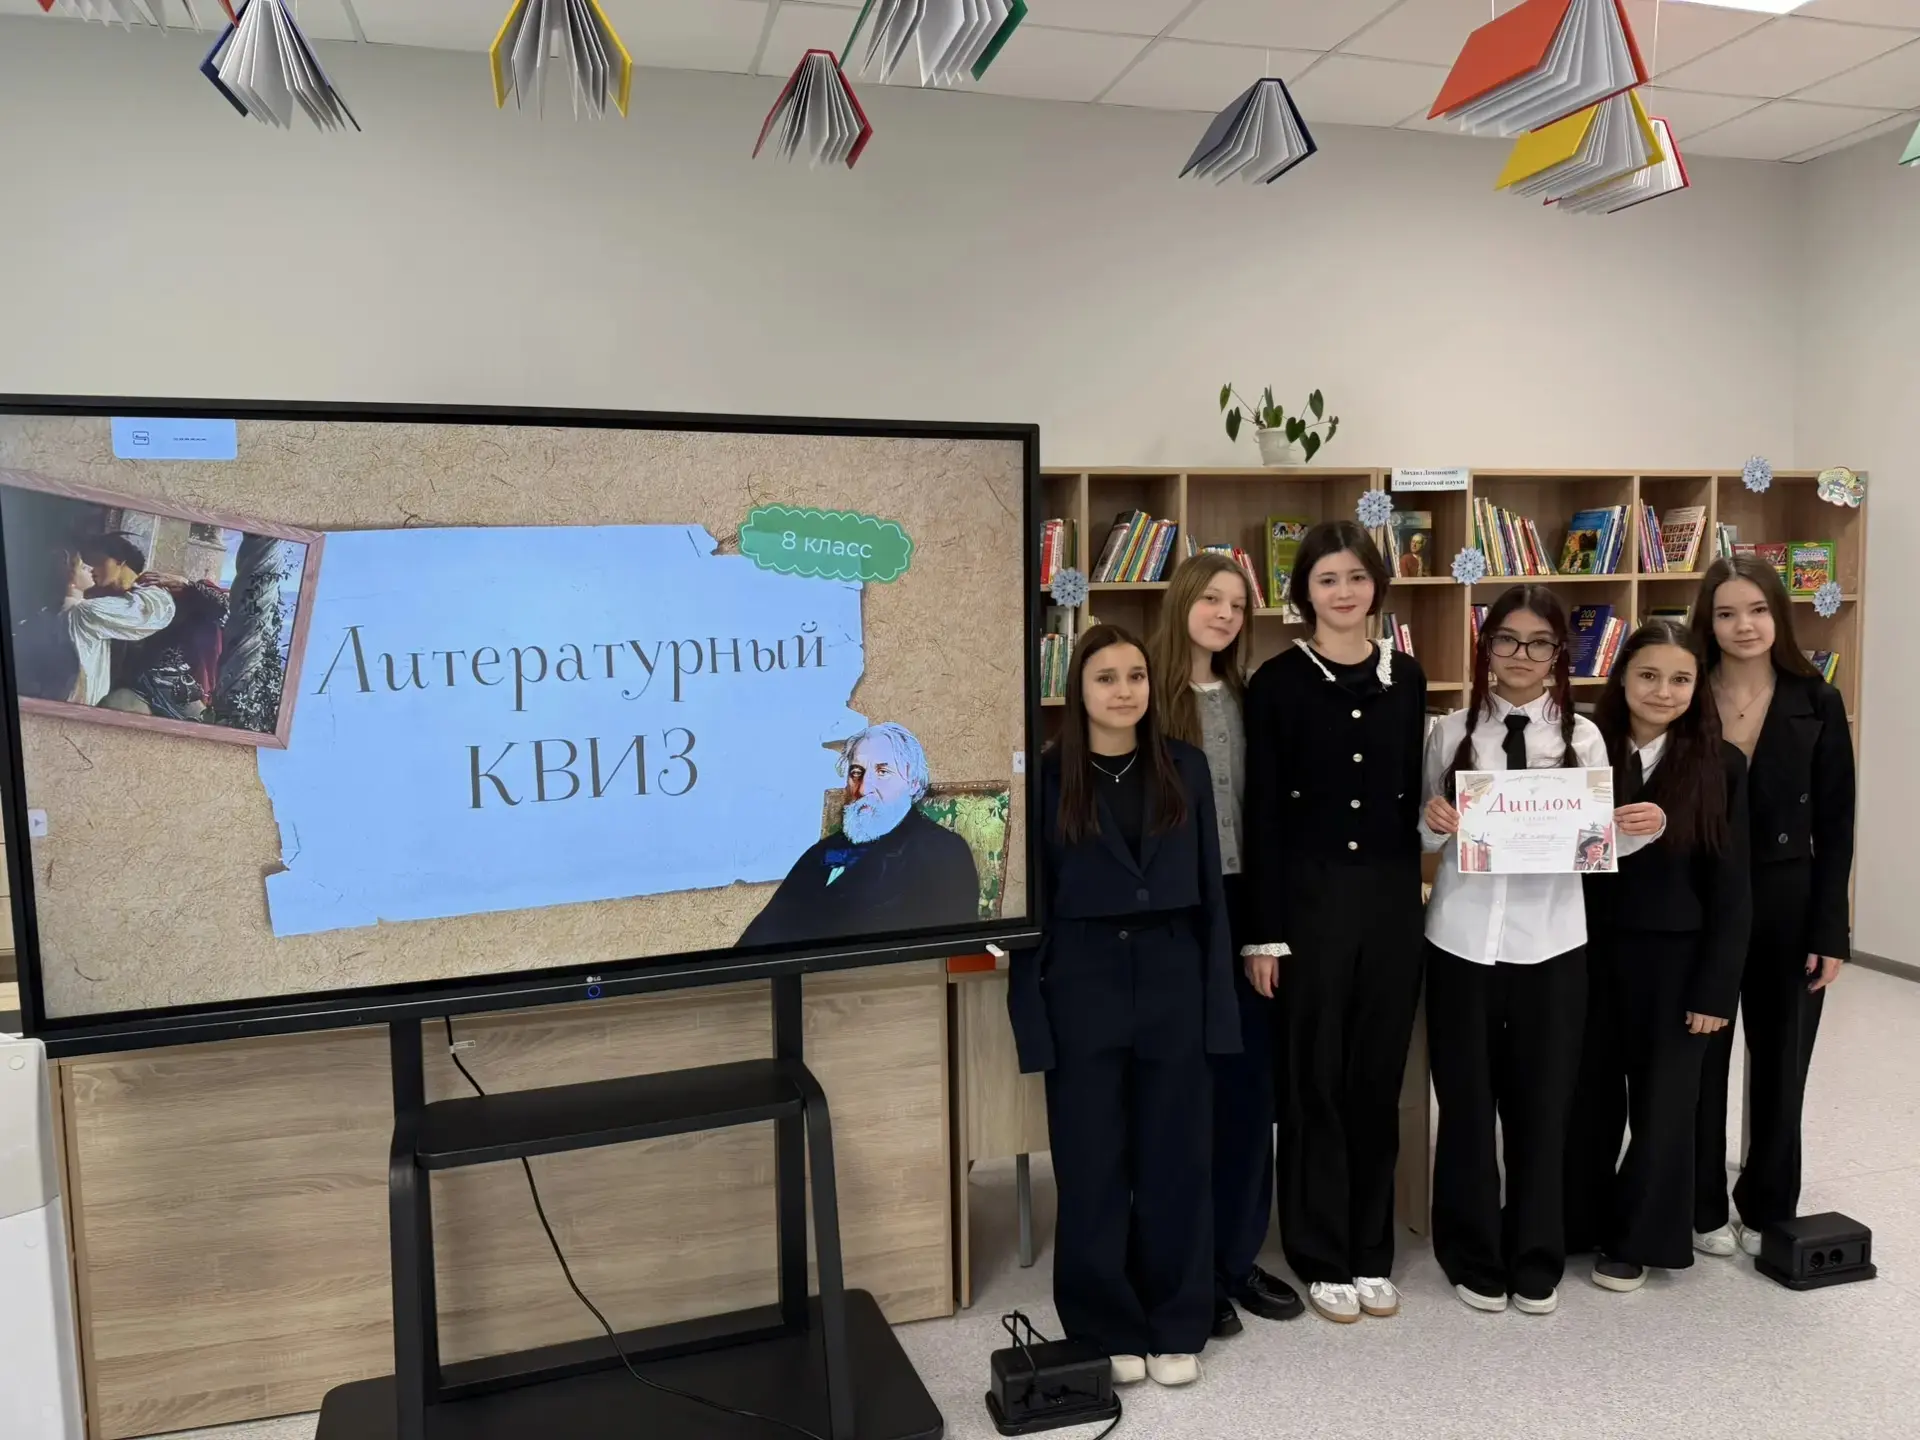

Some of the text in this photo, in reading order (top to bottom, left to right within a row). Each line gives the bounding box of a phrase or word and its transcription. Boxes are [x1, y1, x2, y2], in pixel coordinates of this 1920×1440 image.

[781, 531, 873, 558] 8 класс
[310, 620, 829, 712] Литературный
[465, 726, 699, 809] КВИЗ
[1486, 792, 1582, 815] Диплом
